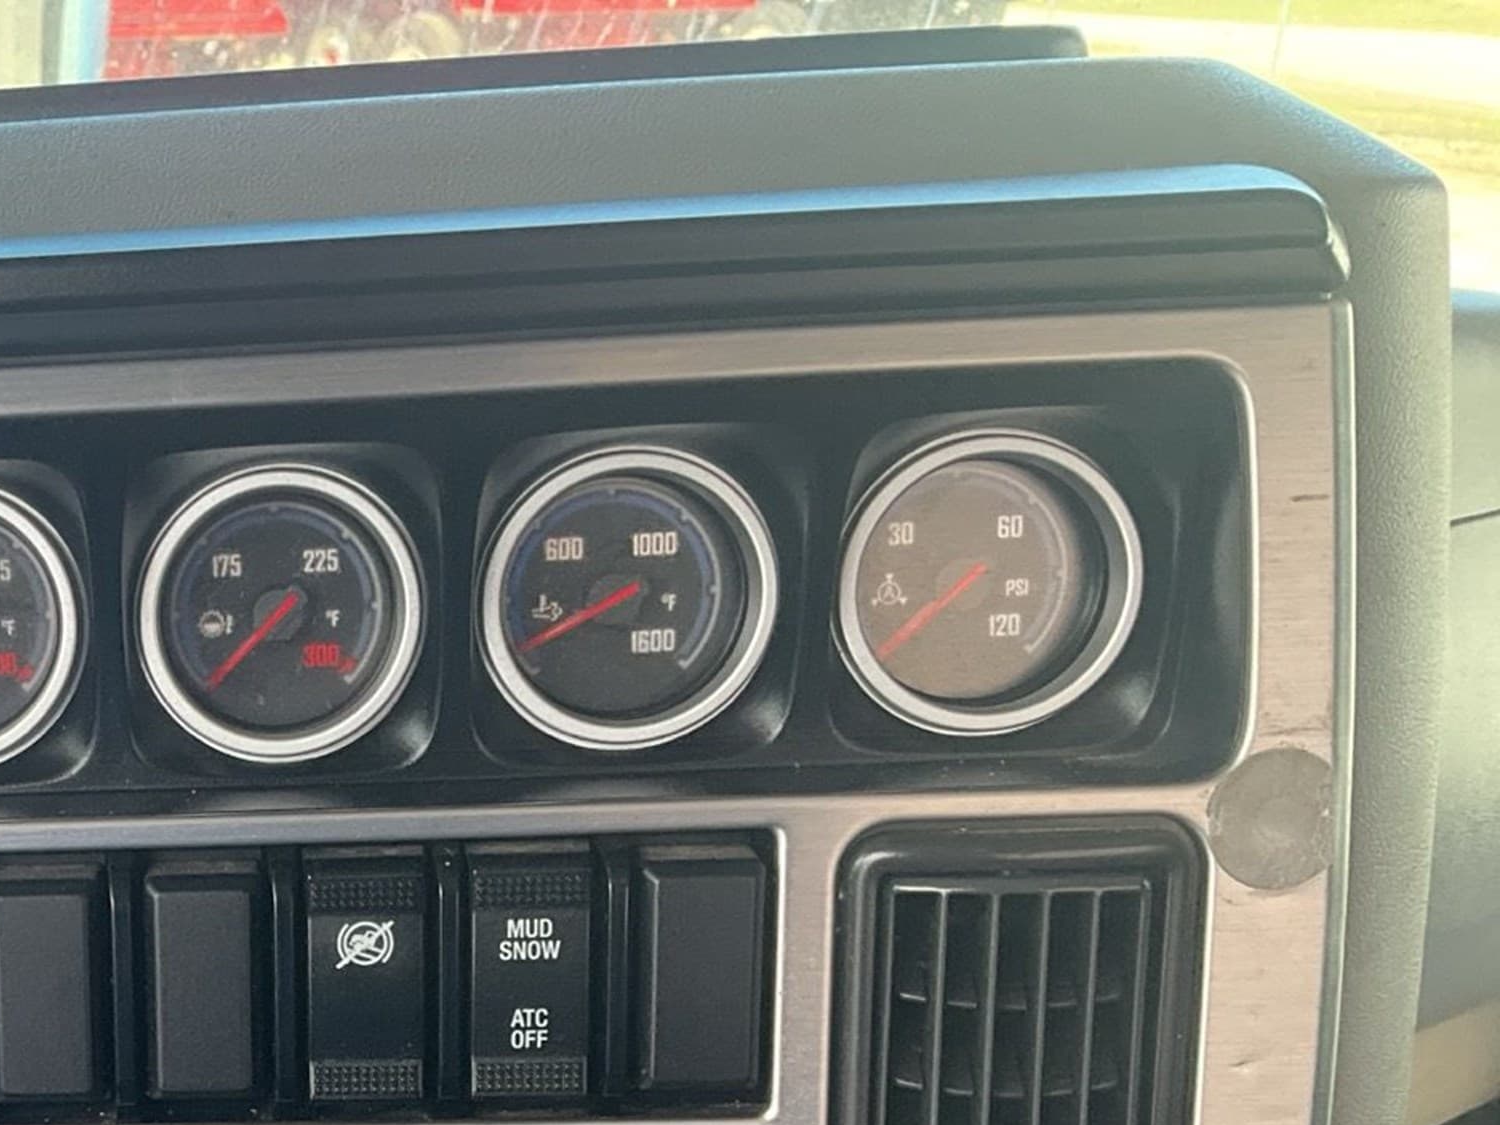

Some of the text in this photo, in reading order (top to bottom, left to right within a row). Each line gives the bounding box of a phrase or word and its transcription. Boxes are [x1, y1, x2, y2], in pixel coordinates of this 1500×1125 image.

[887, 521, 914, 546] 30
[996, 514, 1023, 539] 60
[545, 537, 584, 561] 600
[632, 531, 678, 557] 1000
[212, 554, 242, 577] 175
[304, 549, 339, 572] 225
[1005, 578, 1029, 596] PSI
[988, 612, 1021, 638] 120
[630, 629, 676, 654] 1600
[302, 642, 340, 667] 300
[506, 918, 554, 940] MUD
[499, 939, 561, 962] SNOW
[510, 1008, 549, 1028] ATC
[510, 1027, 549, 1049] OFF
